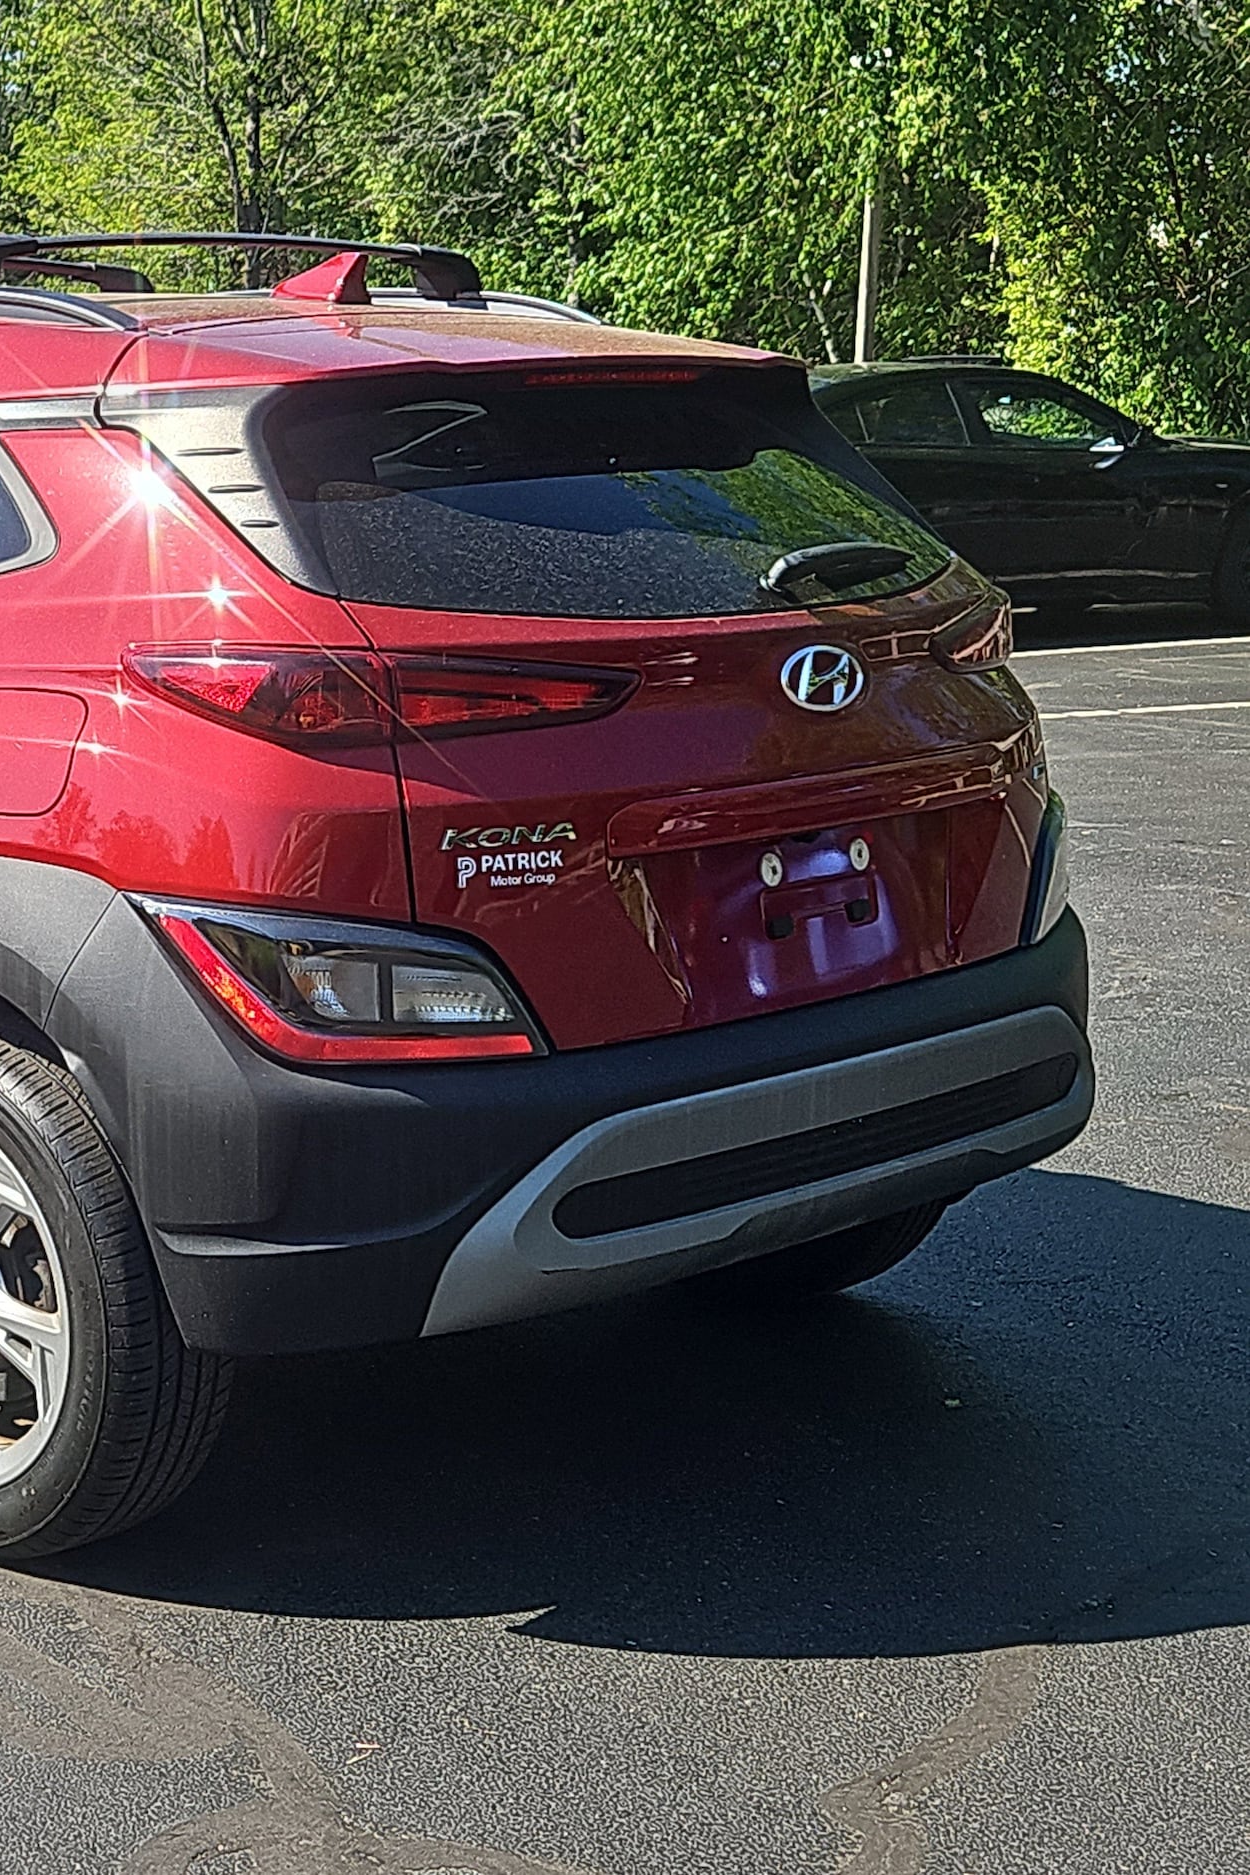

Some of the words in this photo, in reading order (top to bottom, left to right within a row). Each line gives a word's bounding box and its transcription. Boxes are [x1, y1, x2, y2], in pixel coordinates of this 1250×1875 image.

[440, 822, 577, 850] KONA
[481, 849, 564, 872] PATRICK
[490, 875, 523, 887] Motor
[523, 872, 556, 886] Group
